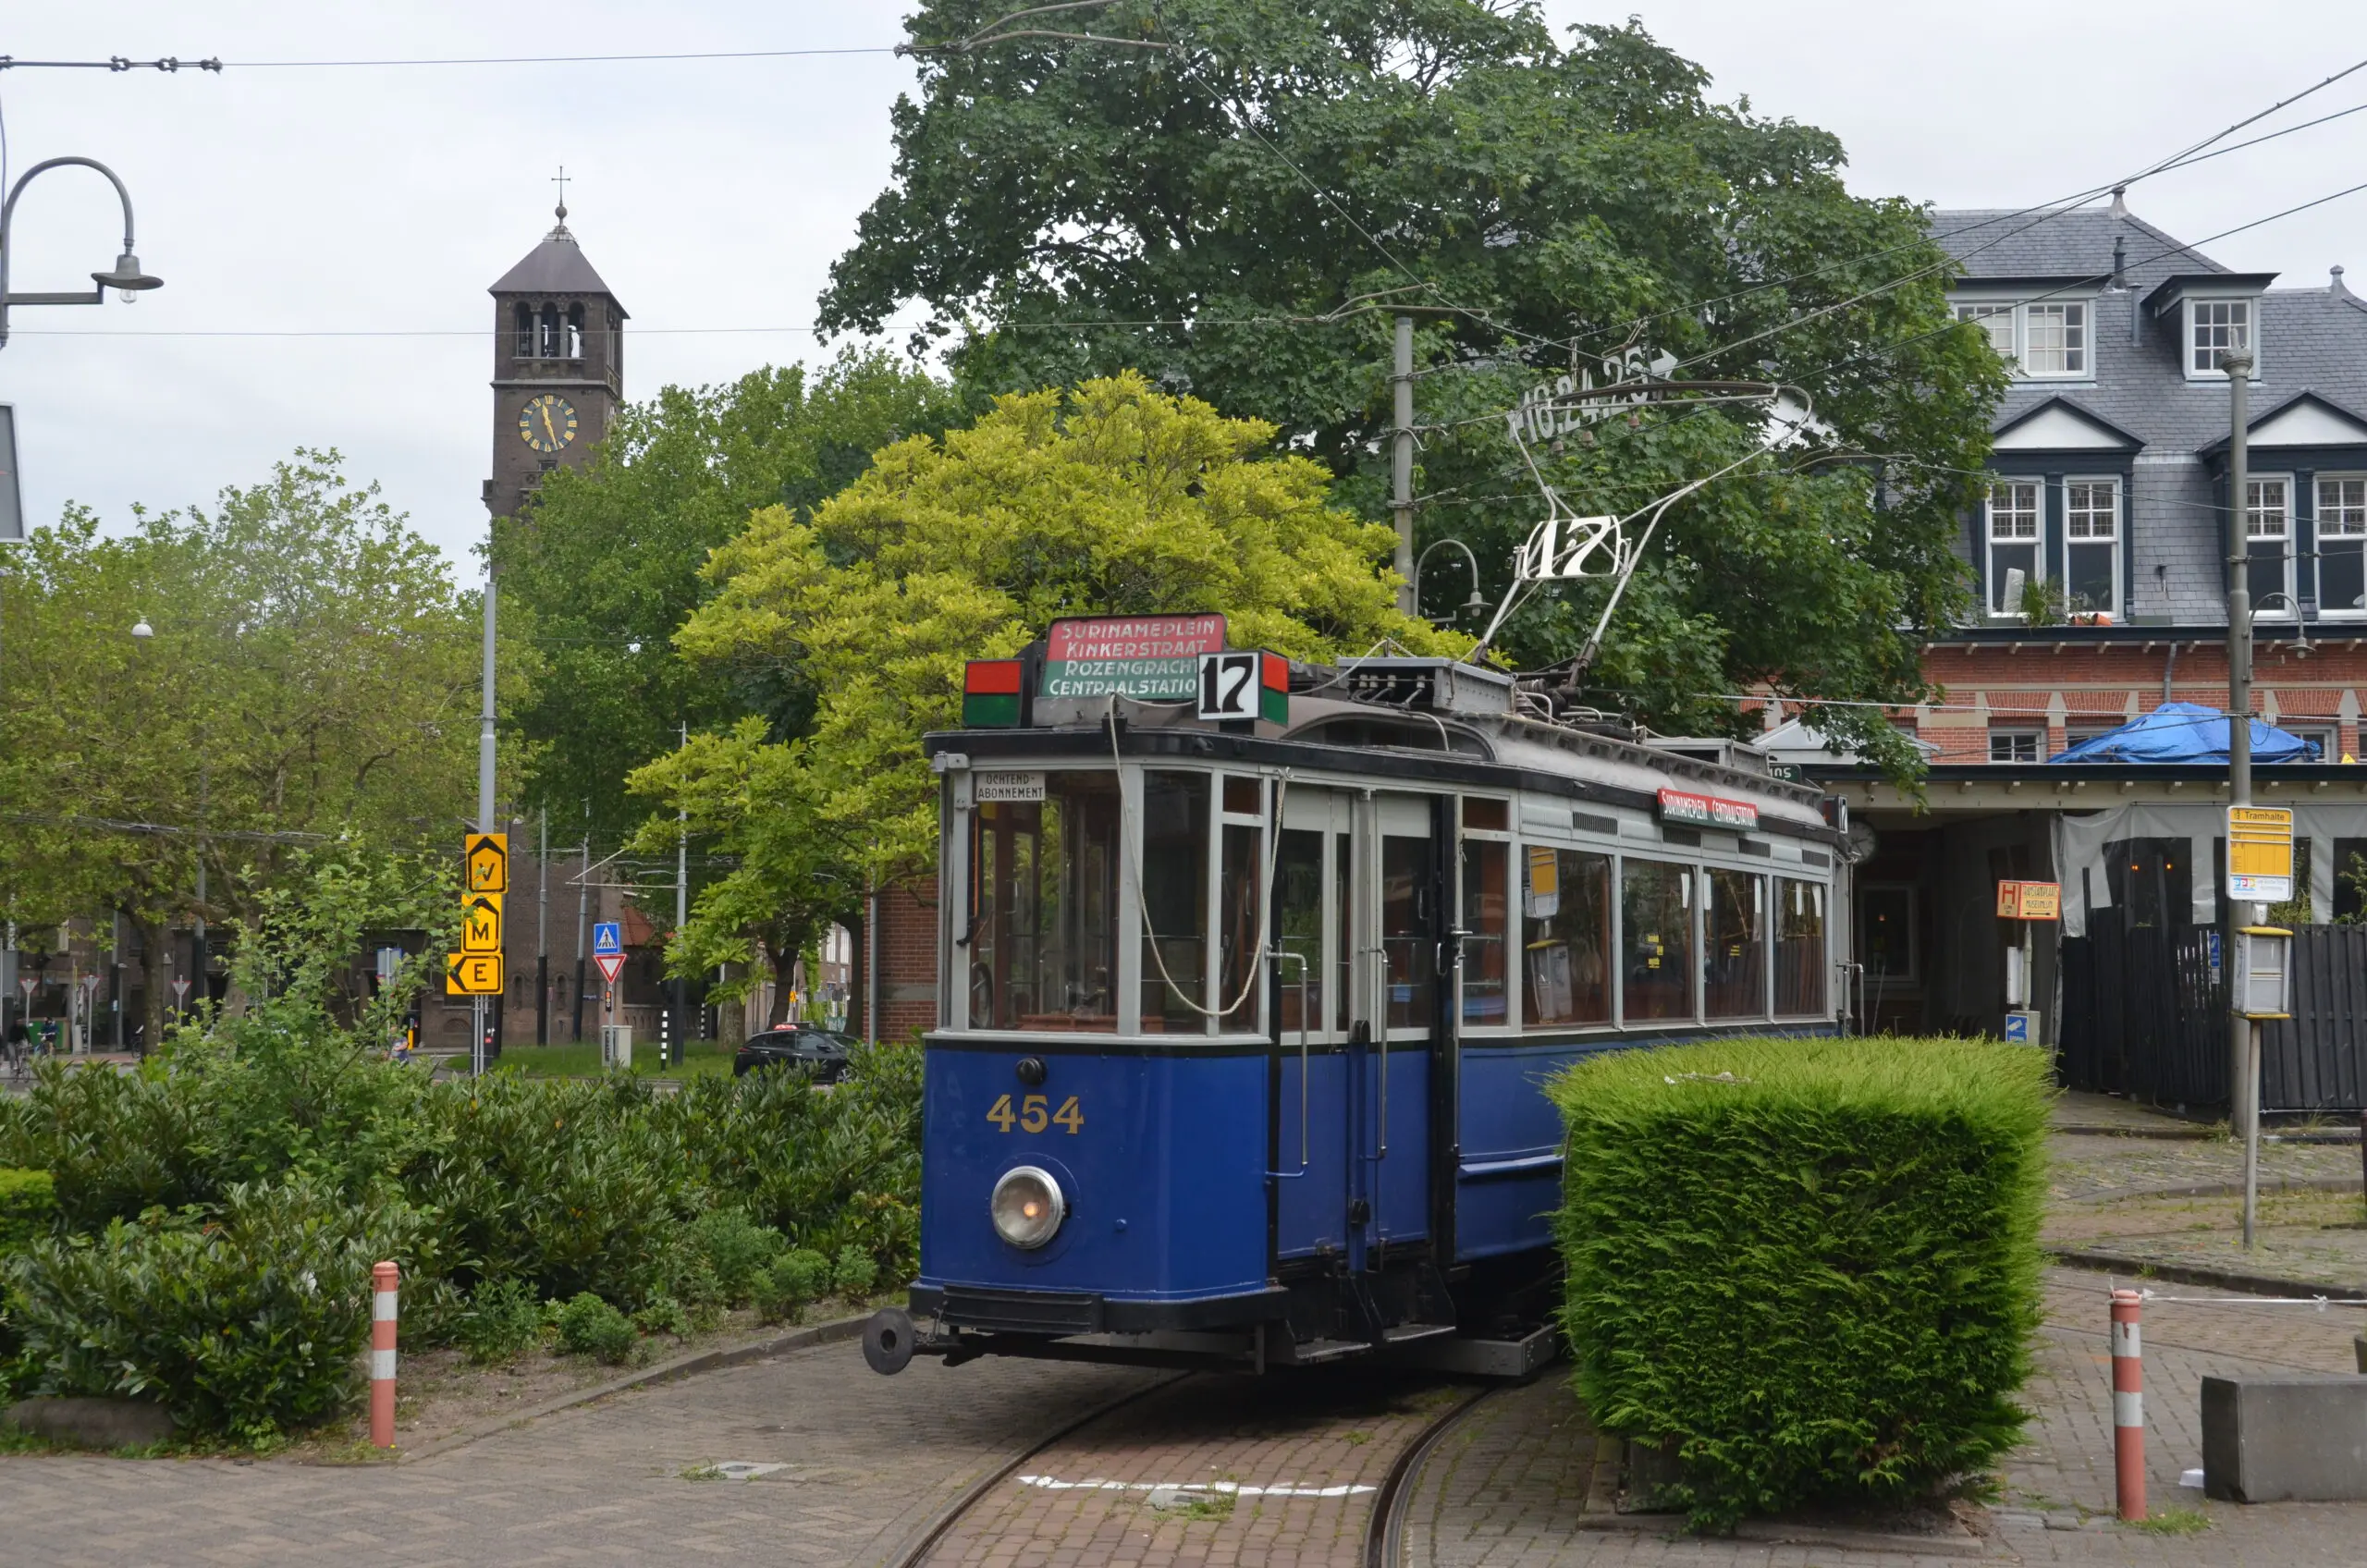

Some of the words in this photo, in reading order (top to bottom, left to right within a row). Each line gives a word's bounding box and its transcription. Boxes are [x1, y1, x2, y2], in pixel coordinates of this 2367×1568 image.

[1536, 516, 1612, 577] 17
[1061, 620, 1215, 640] SURINAMEPLEIN
[1066, 640, 1208, 658] KINKERSTRAAT
[1049, 679, 1196, 695] CENTRAALSTATIO
[1200, 655, 1254, 714] 17
[986, 773, 1035, 785] OCHTEND-
[977, 787, 1044, 799] ABONNEMENT
[1662, 790, 1709, 820] SURINAMEPLEIN
[1711, 799, 1757, 827] CENTRAALSTATION
[2245, 811, 2285, 821] Tramhalte
[479, 863, 496, 881] V
[2002, 884, 2016, 904] H
[472, 923, 489, 941] M
[474, 963, 487, 982] E
[987, 1094, 1085, 1134] 454
